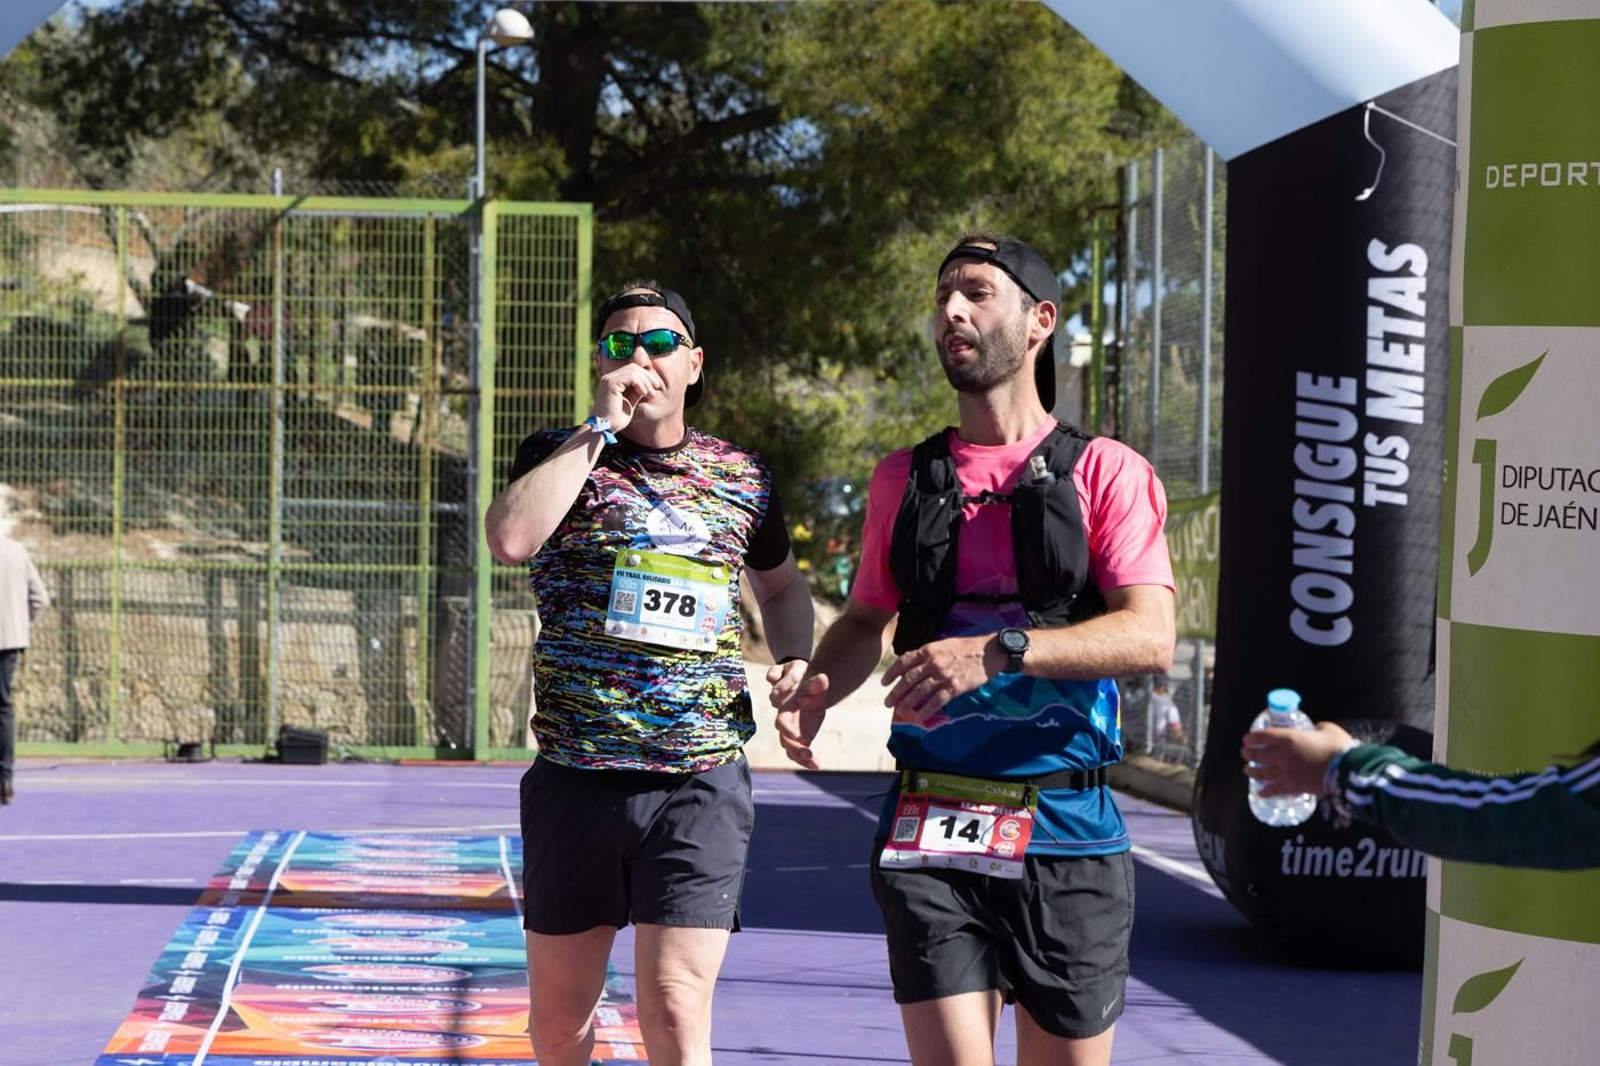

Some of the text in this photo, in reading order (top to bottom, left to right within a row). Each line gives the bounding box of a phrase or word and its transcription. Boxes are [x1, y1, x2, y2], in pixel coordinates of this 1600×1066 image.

[1363, 237, 1429, 507] TUS METAS
[1502, 465, 1600, 493] DIPUTAC
[1289, 371, 1359, 647] CONSIGUE
[1501, 501, 1598, 531] DE JAÉN
[642, 574, 671, 585] SOLIDARIO
[643, 588, 697, 618] 378
[939, 815, 981, 843] 14
[1281, 834, 1428, 878] time2run
